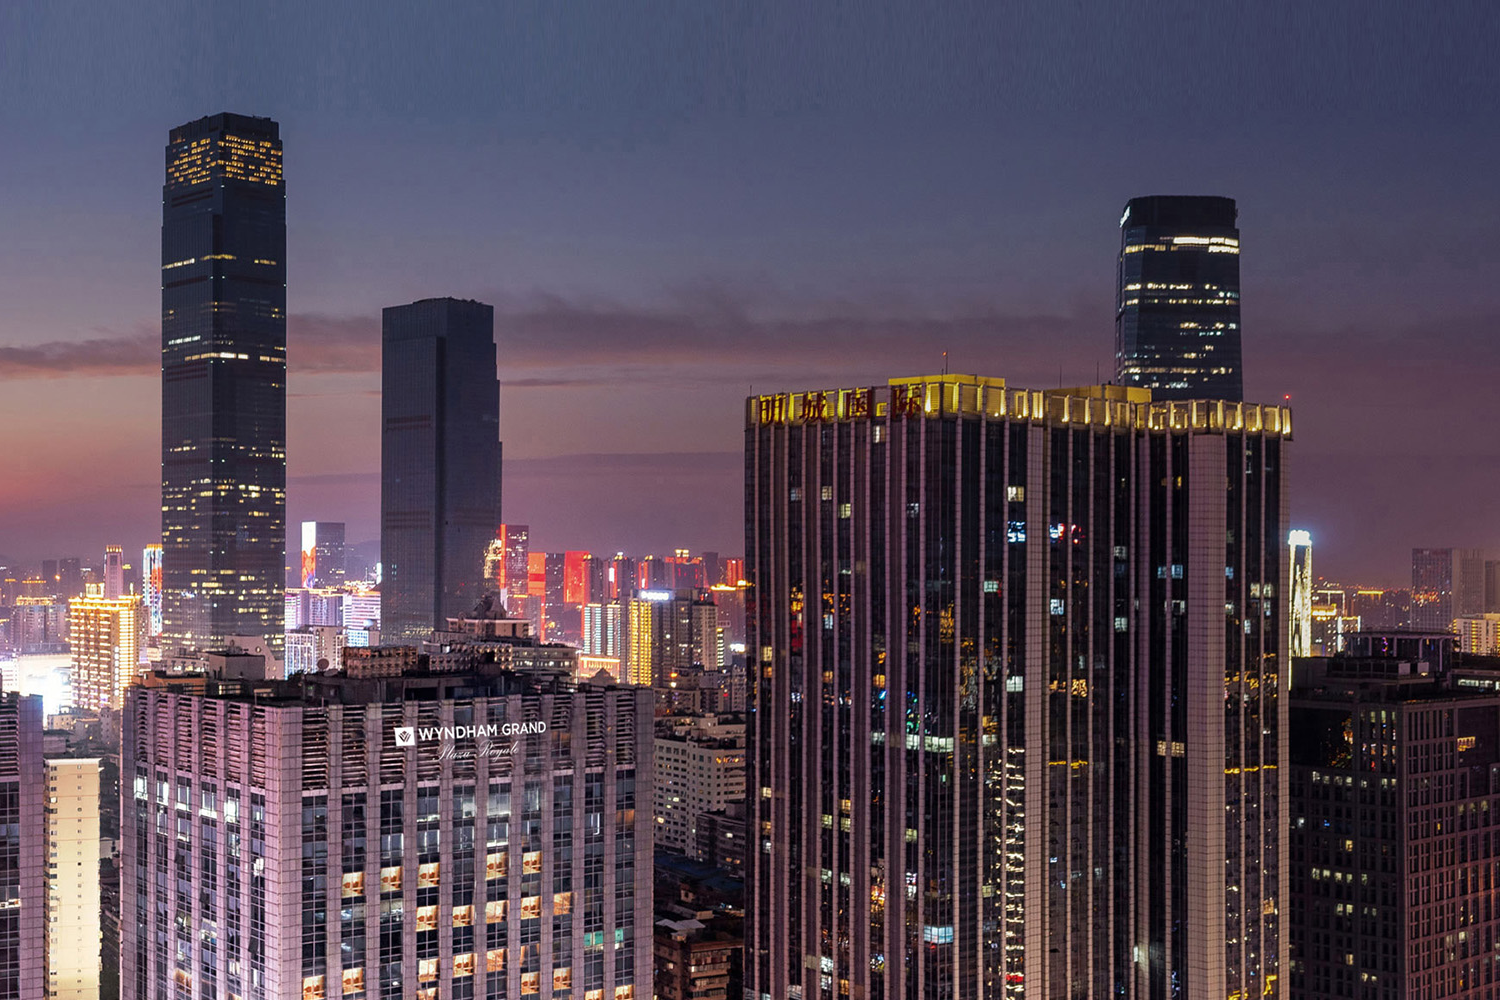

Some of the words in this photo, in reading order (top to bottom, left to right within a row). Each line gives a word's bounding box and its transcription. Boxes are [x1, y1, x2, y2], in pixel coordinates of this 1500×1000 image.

[759, 384, 922, 426] 明城国际
[418, 724, 498, 741] WYNDHAM
[502, 721, 547, 736] GRAND
[432, 743, 470, 762] Plaza
[475, 739, 519, 762] Royale
